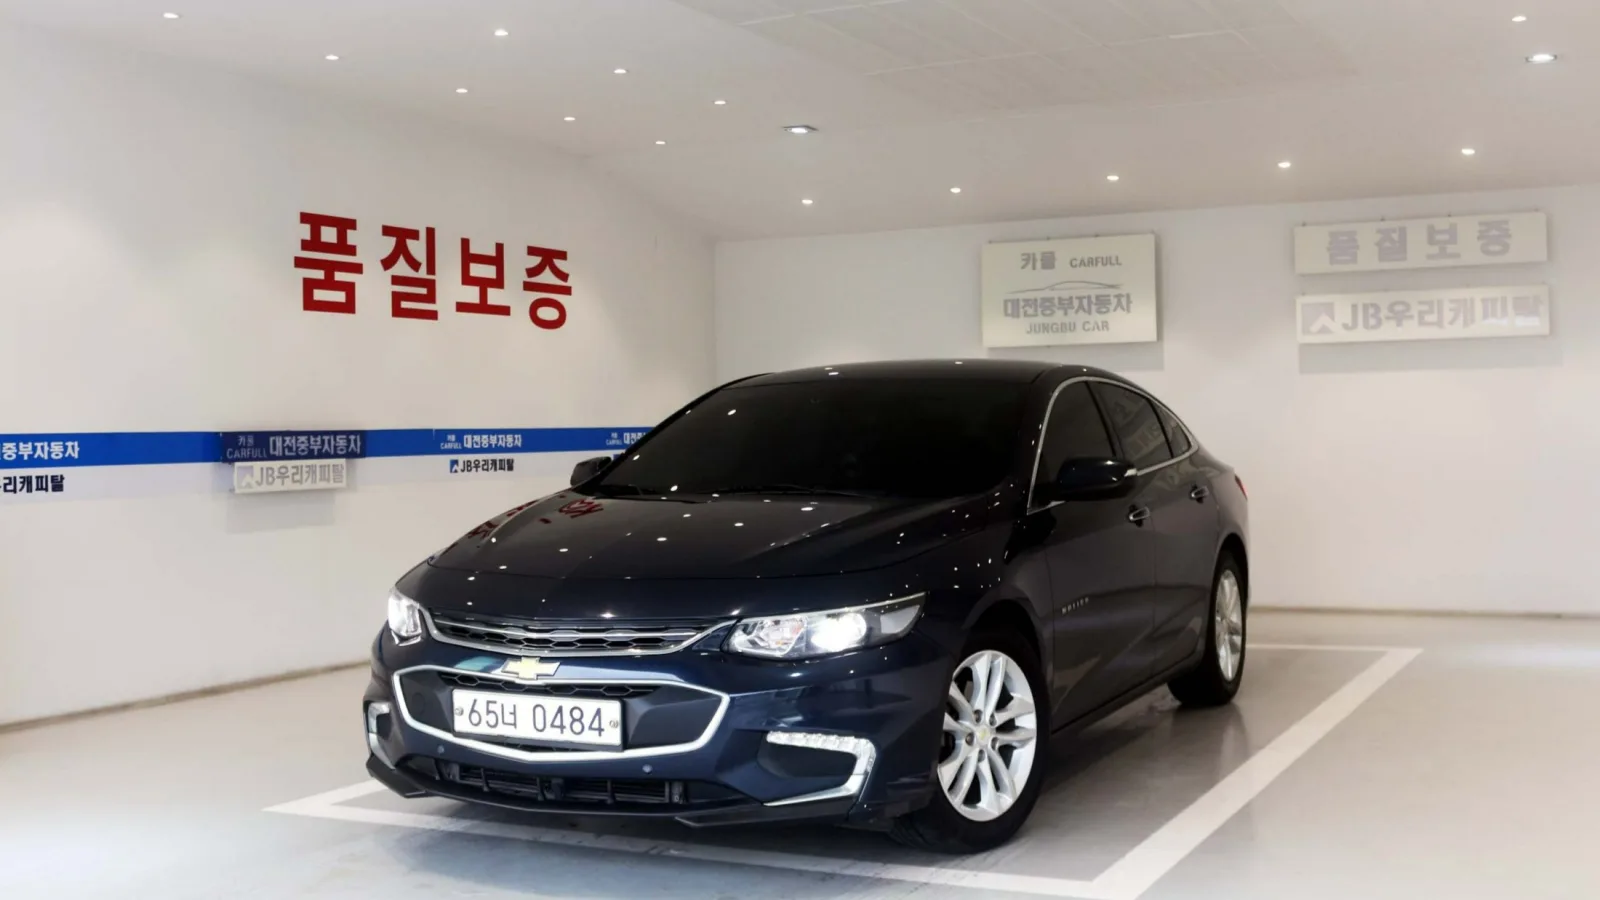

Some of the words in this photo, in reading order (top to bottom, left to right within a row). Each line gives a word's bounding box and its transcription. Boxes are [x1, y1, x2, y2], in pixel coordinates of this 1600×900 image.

[1327, 219, 1512, 266] 품질보증
[294, 211, 572, 330] 품질보증
[1069, 255, 1122, 269] CARFULL
[1003, 292, 1133, 319] 대전중부자동차
[1026, 322, 1077, 335] JUNGBU
[1082, 320, 1110, 332] CAR
[0, 441, 80, 460] 중부자동차
[269, 434, 362, 456] 대전중부자동차
[463, 433, 522, 448] 대전중부자동차
[0, 474, 65, 494] 리캐피탈
[255, 463, 345, 486] JB우리캐피탈
[468, 698, 517, 729] 65너
[532, 703, 605, 737] 0484
